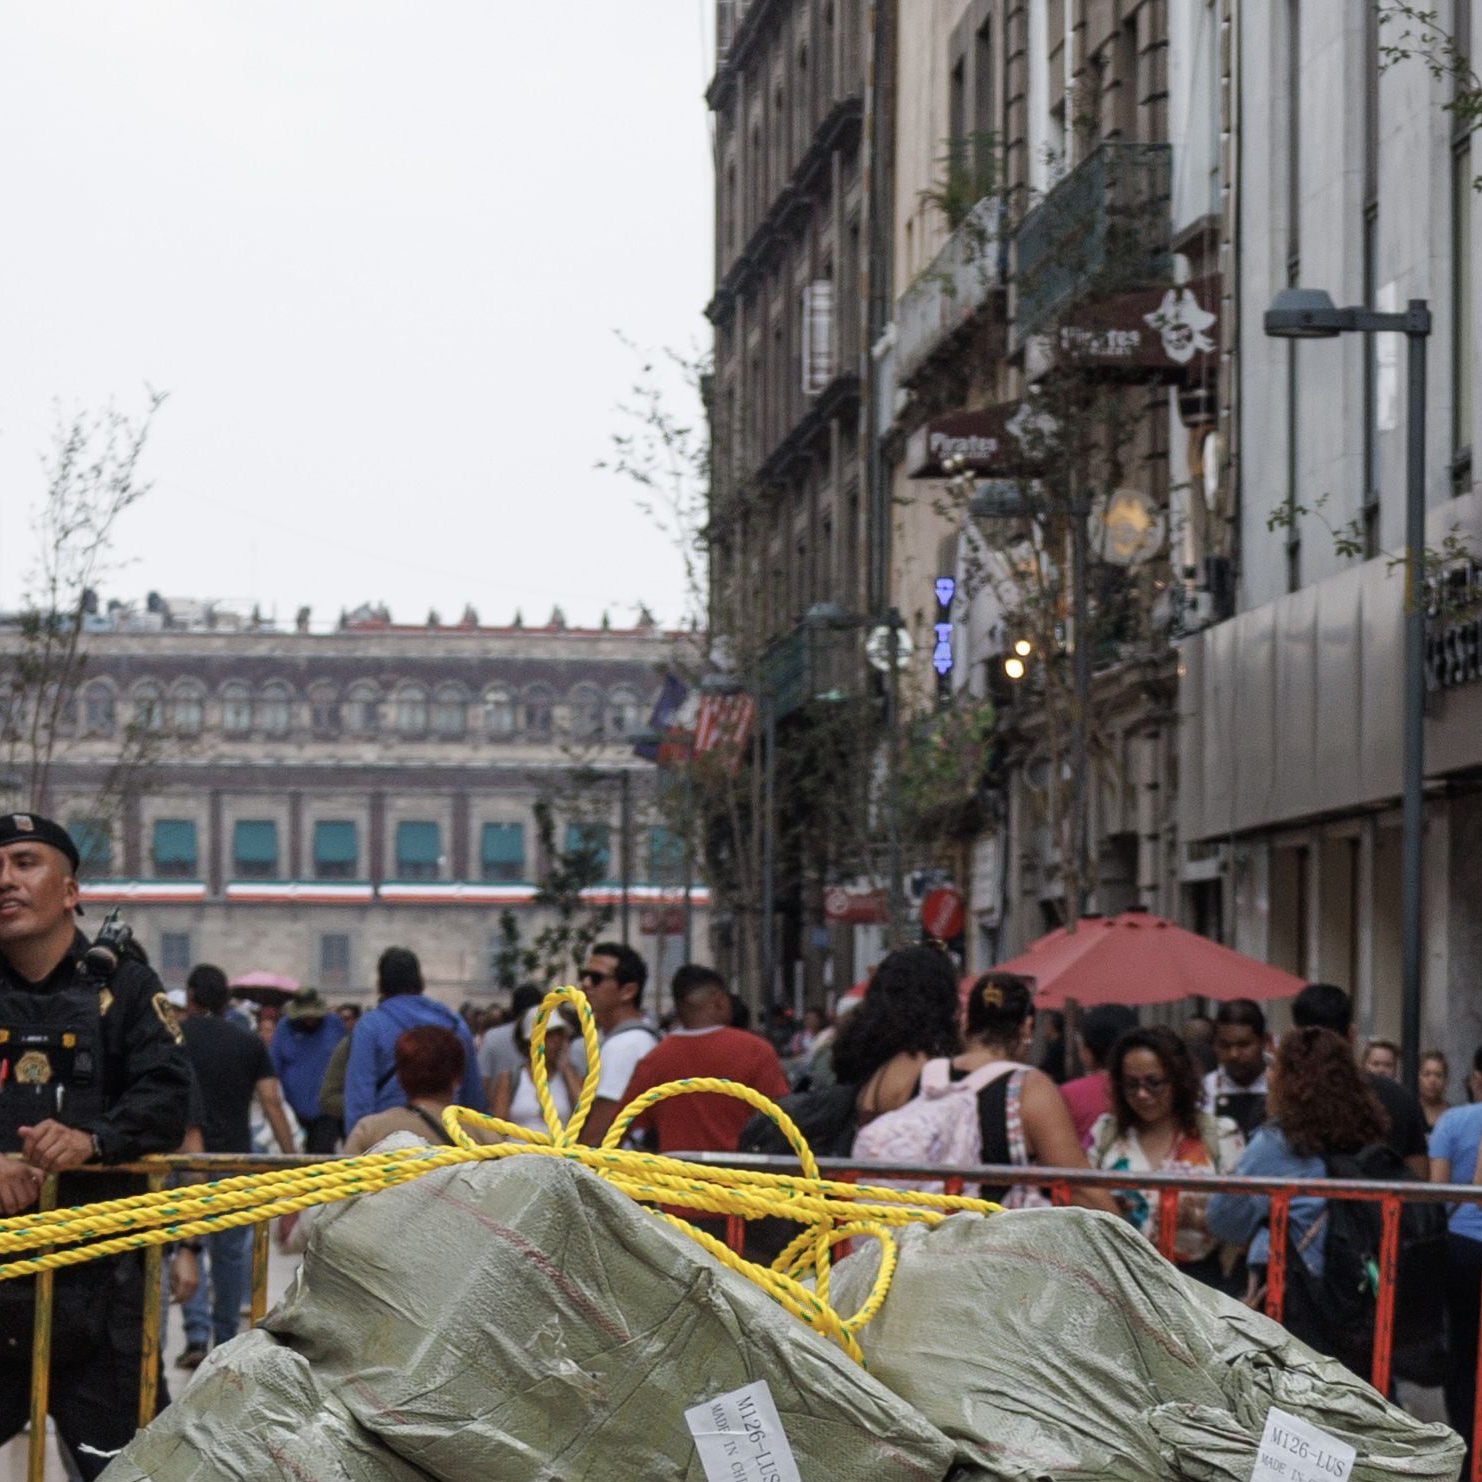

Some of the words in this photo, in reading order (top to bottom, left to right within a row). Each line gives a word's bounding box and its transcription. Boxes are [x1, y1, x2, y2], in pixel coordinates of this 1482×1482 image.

[710, 1403, 731, 1433] MADE
[723, 1440, 738, 1457] IN
[1270, 1427, 1346, 1478] M126-LUS
[1261, 1453, 1287, 1475] MADE
[1291, 1468, 1304, 1482] IN
